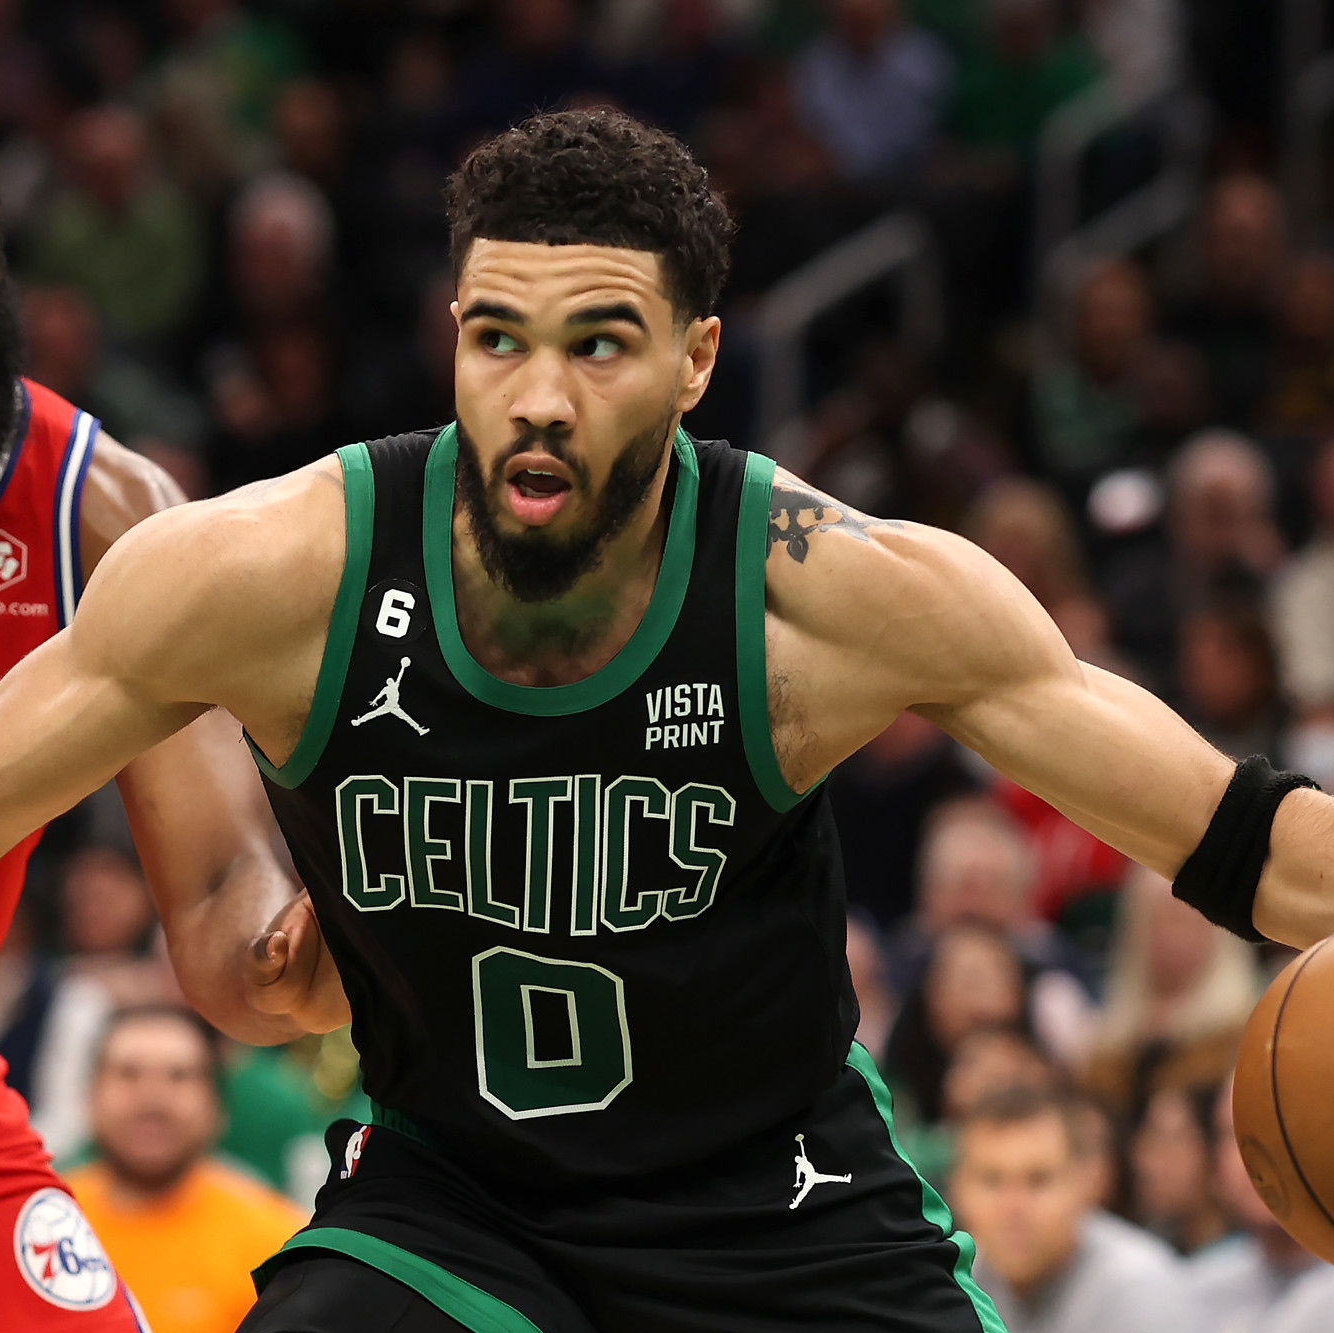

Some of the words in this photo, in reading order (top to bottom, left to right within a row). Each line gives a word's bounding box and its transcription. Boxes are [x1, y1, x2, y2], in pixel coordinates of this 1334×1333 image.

[375, 588, 415, 638] 6
[646, 683, 725, 724] VISTA
[645, 720, 725, 750] PRINT
[336, 774, 736, 936] CELTICS
[472, 946, 633, 1121] 0
